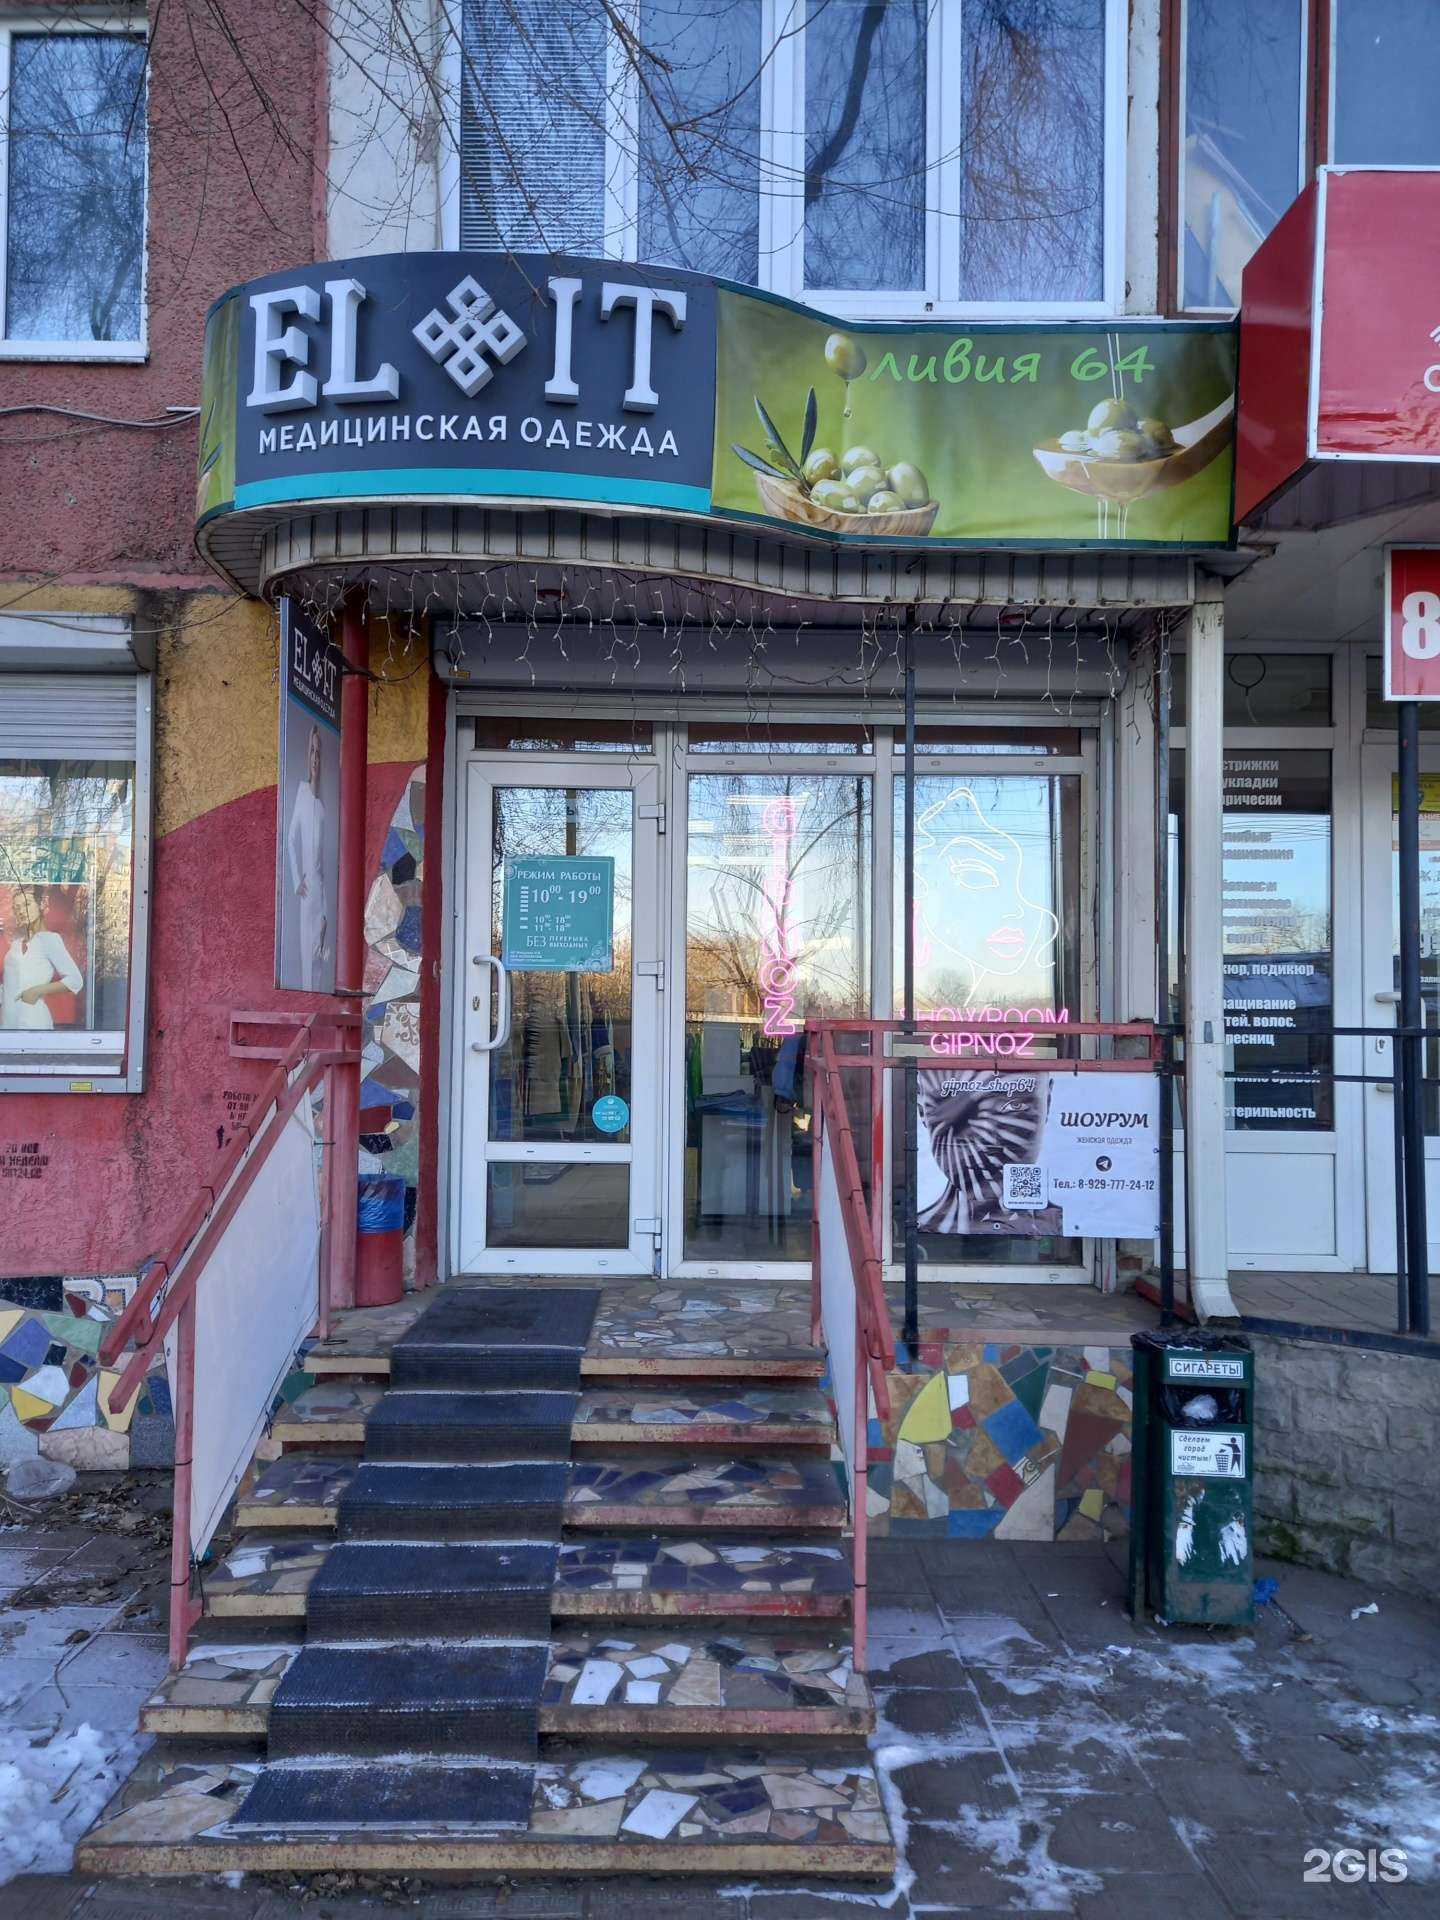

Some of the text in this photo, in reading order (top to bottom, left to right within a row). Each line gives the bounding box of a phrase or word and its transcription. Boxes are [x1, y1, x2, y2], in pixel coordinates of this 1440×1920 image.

[247, 276, 687, 415] EL IT
[1070, 345, 1155, 383] 64
[259, 415, 680, 457] МЕДИЦИНСКАЯ ОДЕЖДА
[294, 627, 311, 682] EL
[517, 870, 601, 881] РЕЖИМ РАБОТЫ
[526, 936, 547, 947] БЕЗ
[1252, 964, 1314, 976] педикюр
[1223, 1000, 1296, 1011] ащивание
[899, 1007, 1069, 1024] HOWROOM
[930, 1032, 1036, 1056] GIPNOZ
[941, 1077, 1035, 1097] gipnoz_shop64
[1060, 1112, 1149, 1128] ШОУРУМ
[1076, 1136, 1105, 1144] ЖЕНСКАЯ
[1053, 1178, 1155, 1190] Тел.: 8-929-777-24-12
[1174, 1362, 1239, 1375] СИГАРЕТЫ
[1178, 1434, 1211, 1443] Сделаем
